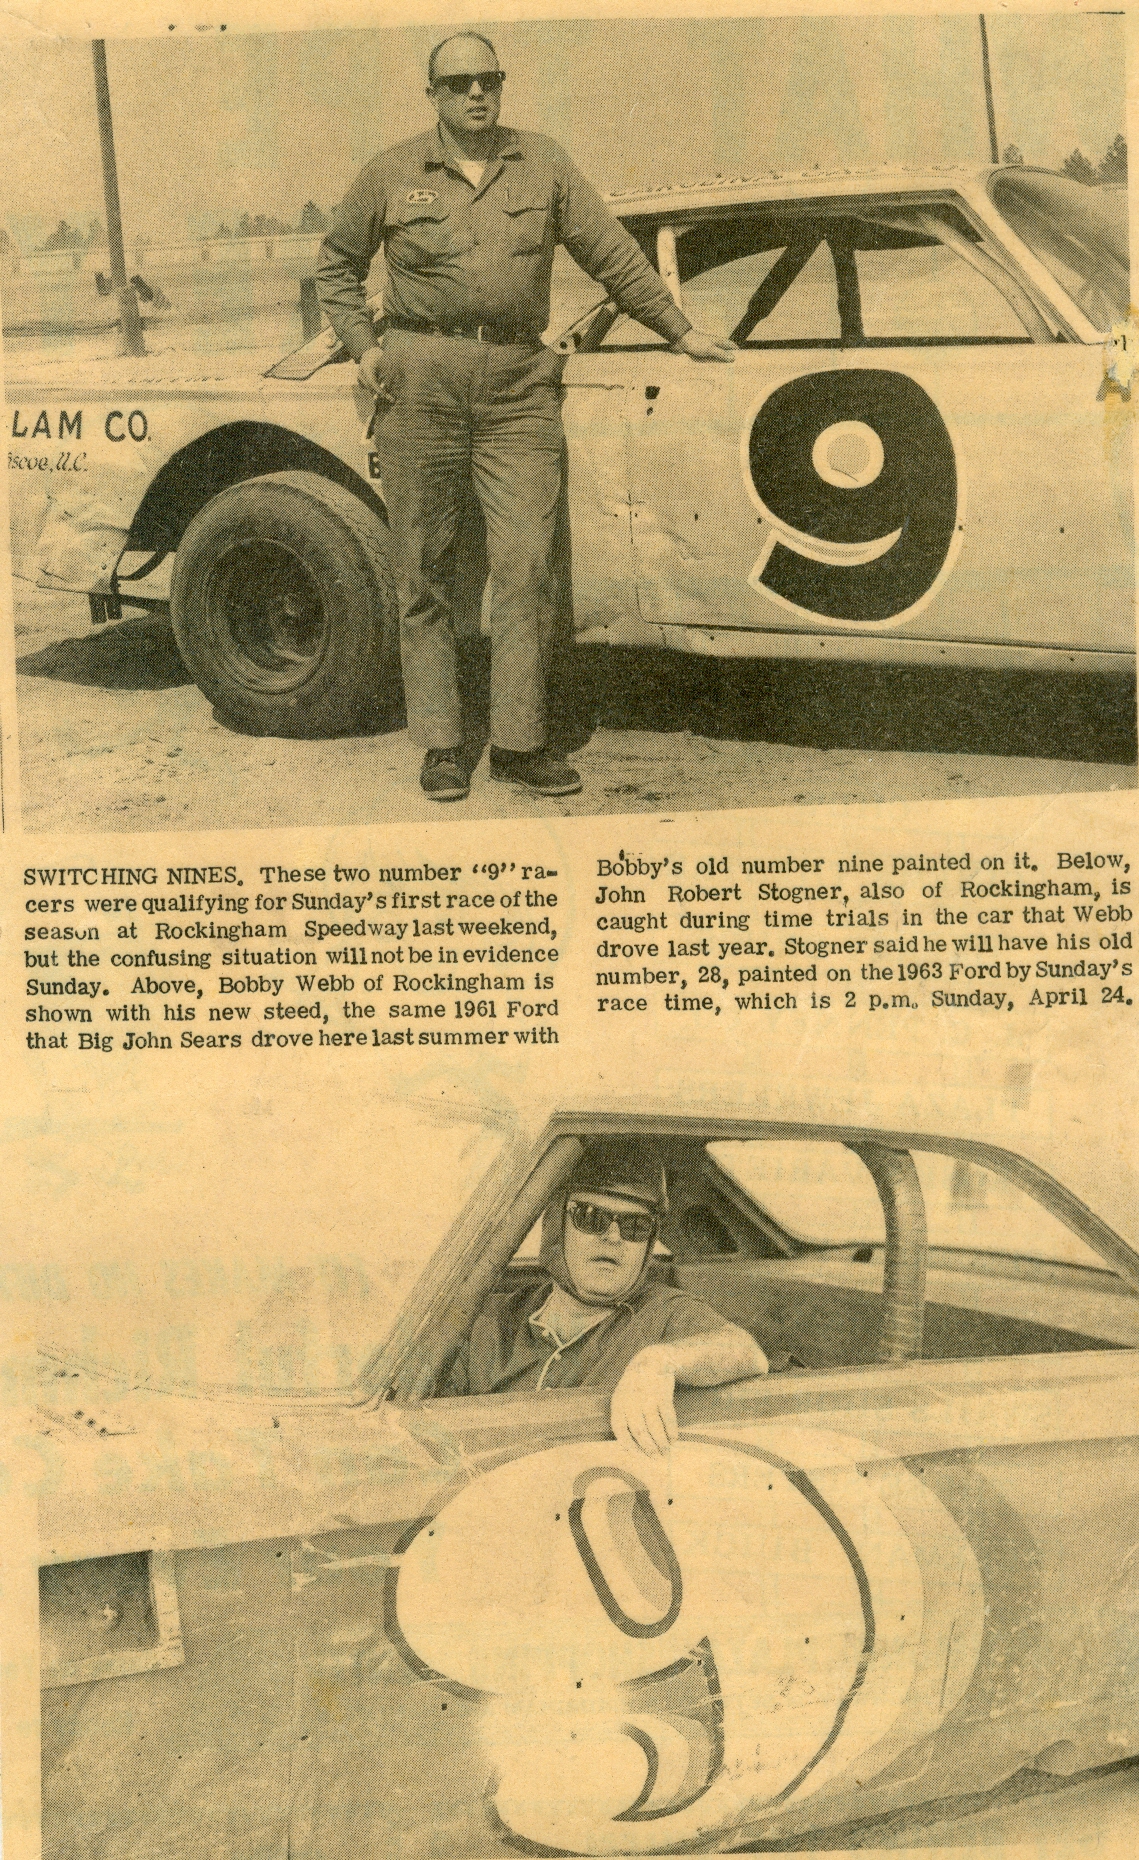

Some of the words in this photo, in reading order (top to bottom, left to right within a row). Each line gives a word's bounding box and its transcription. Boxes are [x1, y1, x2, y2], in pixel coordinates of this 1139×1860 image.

[11, 409, 83, 440] LAM
[104, 409, 152, 443] CO.
[744, 364, 962, 626] 9
[23, 867, 158, 886] SWITCHING
[166, 866, 244, 887] NINES.
[259, 865, 326, 884] These
[333, 863, 371, 883] two
[378, 863, 462, 883] number
[521, 866, 558, 881] ra-
[596, 857, 683, 880] Bobby's
[696, 856, 729, 876] old
[741, 855, 825, 875] number
[838, 854, 884, 873] nine
[891, 852, 972, 876] painted
[980, 857, 1005, 871] on
[1014, 851, 1038, 872] it.
[1057, 851, 1131, 874] Below,
[25, 898, 75, 913] cers
[84, 898, 137, 912] were
[141, 893, 250, 916] qualifying
[254, 893, 288, 911] for
[291, 891, 387, 914] Sunday's
[391, 890, 442, 909] first
[446, 894, 495, 909] race
[499, 890, 522, 909] of
[524, 889, 558, 908] the
[594, 885, 646, 905] John
[667, 882, 743, 903] Robert
[758, 882, 849, 905] Stogner,
[860, 882, 905, 900] also
[922, 881, 944, 899] of
[960, 879, 1101, 902] Rockingham,
[1111, 877, 1131, 895] is
[24, 926, 100, 941] season
[117, 921, 138, 940] at
[154, 920, 288, 943] Rockingham
[304, 919, 409, 941] Speedway
[412, 917, 455, 938] last
[457, 916, 557, 941] weekend,
[596, 911, 668, 934] caught
[679, 911, 751, 932] during
[763, 910, 813, 928] time
[825, 908, 889, 927] trials
[902, 908, 923, 927] in
[935, 907, 968, 926] the
[977, 910, 1014, 925] car
[1022, 905, 1066, 924] that
[1072, 904, 1133, 923] Webb
[23, 950, 59, 968] but
[67, 949, 100, 968] the
[110, 949, 212, 970] confusing
[221, 947, 318, 966] situation
[325, 946, 368, 965] will
[371, 945, 405, 964] not
[407, 946, 433, 964] be
[438, 946, 459, 964] in
[462, 945, 559, 963] evidence
[596, 940, 659, 958] drove
[667, 938, 710, 958] last
[718, 941, 775, 960] year.
[784, 936, 868, 958] Stogner
[873, 935, 919, 954] said
[923, 935, 947, 953] he
[951, 934, 994, 953] will
[997, 934, 1048, 951] have
[1056, 933, 1091, 951] his
[1099, 931, 1133, 950] old
[26, 977, 110, 999] Sunday.
[130, 976, 204, 1000] Above,
[218, 975, 285, 997] Bobby
[295, 974, 355, 992] Webb
[363, 974, 384, 992] of
[392, 972, 525, 994] Rockingham
[534, 972, 554, 990] is
[595, 966, 688, 990] number,
[698, 965, 729, 990] 28,
[738, 963, 818, 987] painted
[826, 968, 852, 982] on
[860, 963, 894, 981] the
[897, 961, 943, 982] 1963
[949, 961, 1002, 981] Ford
[1005, 961, 1032, 983] by
[1035, 958, 1133, 981] Sunday's
[25, 1004, 93, 1023] shown
[105, 1003, 151, 1022] with
[163, 1003, 196, 1022] his
[208, 1006, 252, 1022] new
[263, 1001, 329, 1025] steed,
[342, 1001, 376, 1019] the
[388, 1004, 446, 1019] same
[454, 1000, 497, 1019] 1961
[506, 999, 559, 1019] Ford
[597, 998, 648, 1012] race
[664, 993, 722, 1017] time,
[734, 992, 798, 1010] which
[810, 991, 831, 1009] is
[844, 991, 857, 1008] 2
[868, 994, 919, 1011] p.m.
[931, 989, 1014, 1012] Sunday,
[1028, 987, 1088, 1009] April
[1101, 985, 1133, 1006] 24.
[25, 1031, 69, 1050] that
[77, 1032, 114, 1053] Big
[122, 1031, 173, 1051] John
[180, 1031, 242, 1049] Sears
[251, 1030, 314, 1048] drove
[318, 1029, 368, 1047] here
[371, 1027, 415, 1047] last
[418, 1030, 510, 1046] summer
[513, 1026, 560, 1045] with
[384, 1432, 878, 1857] 9
